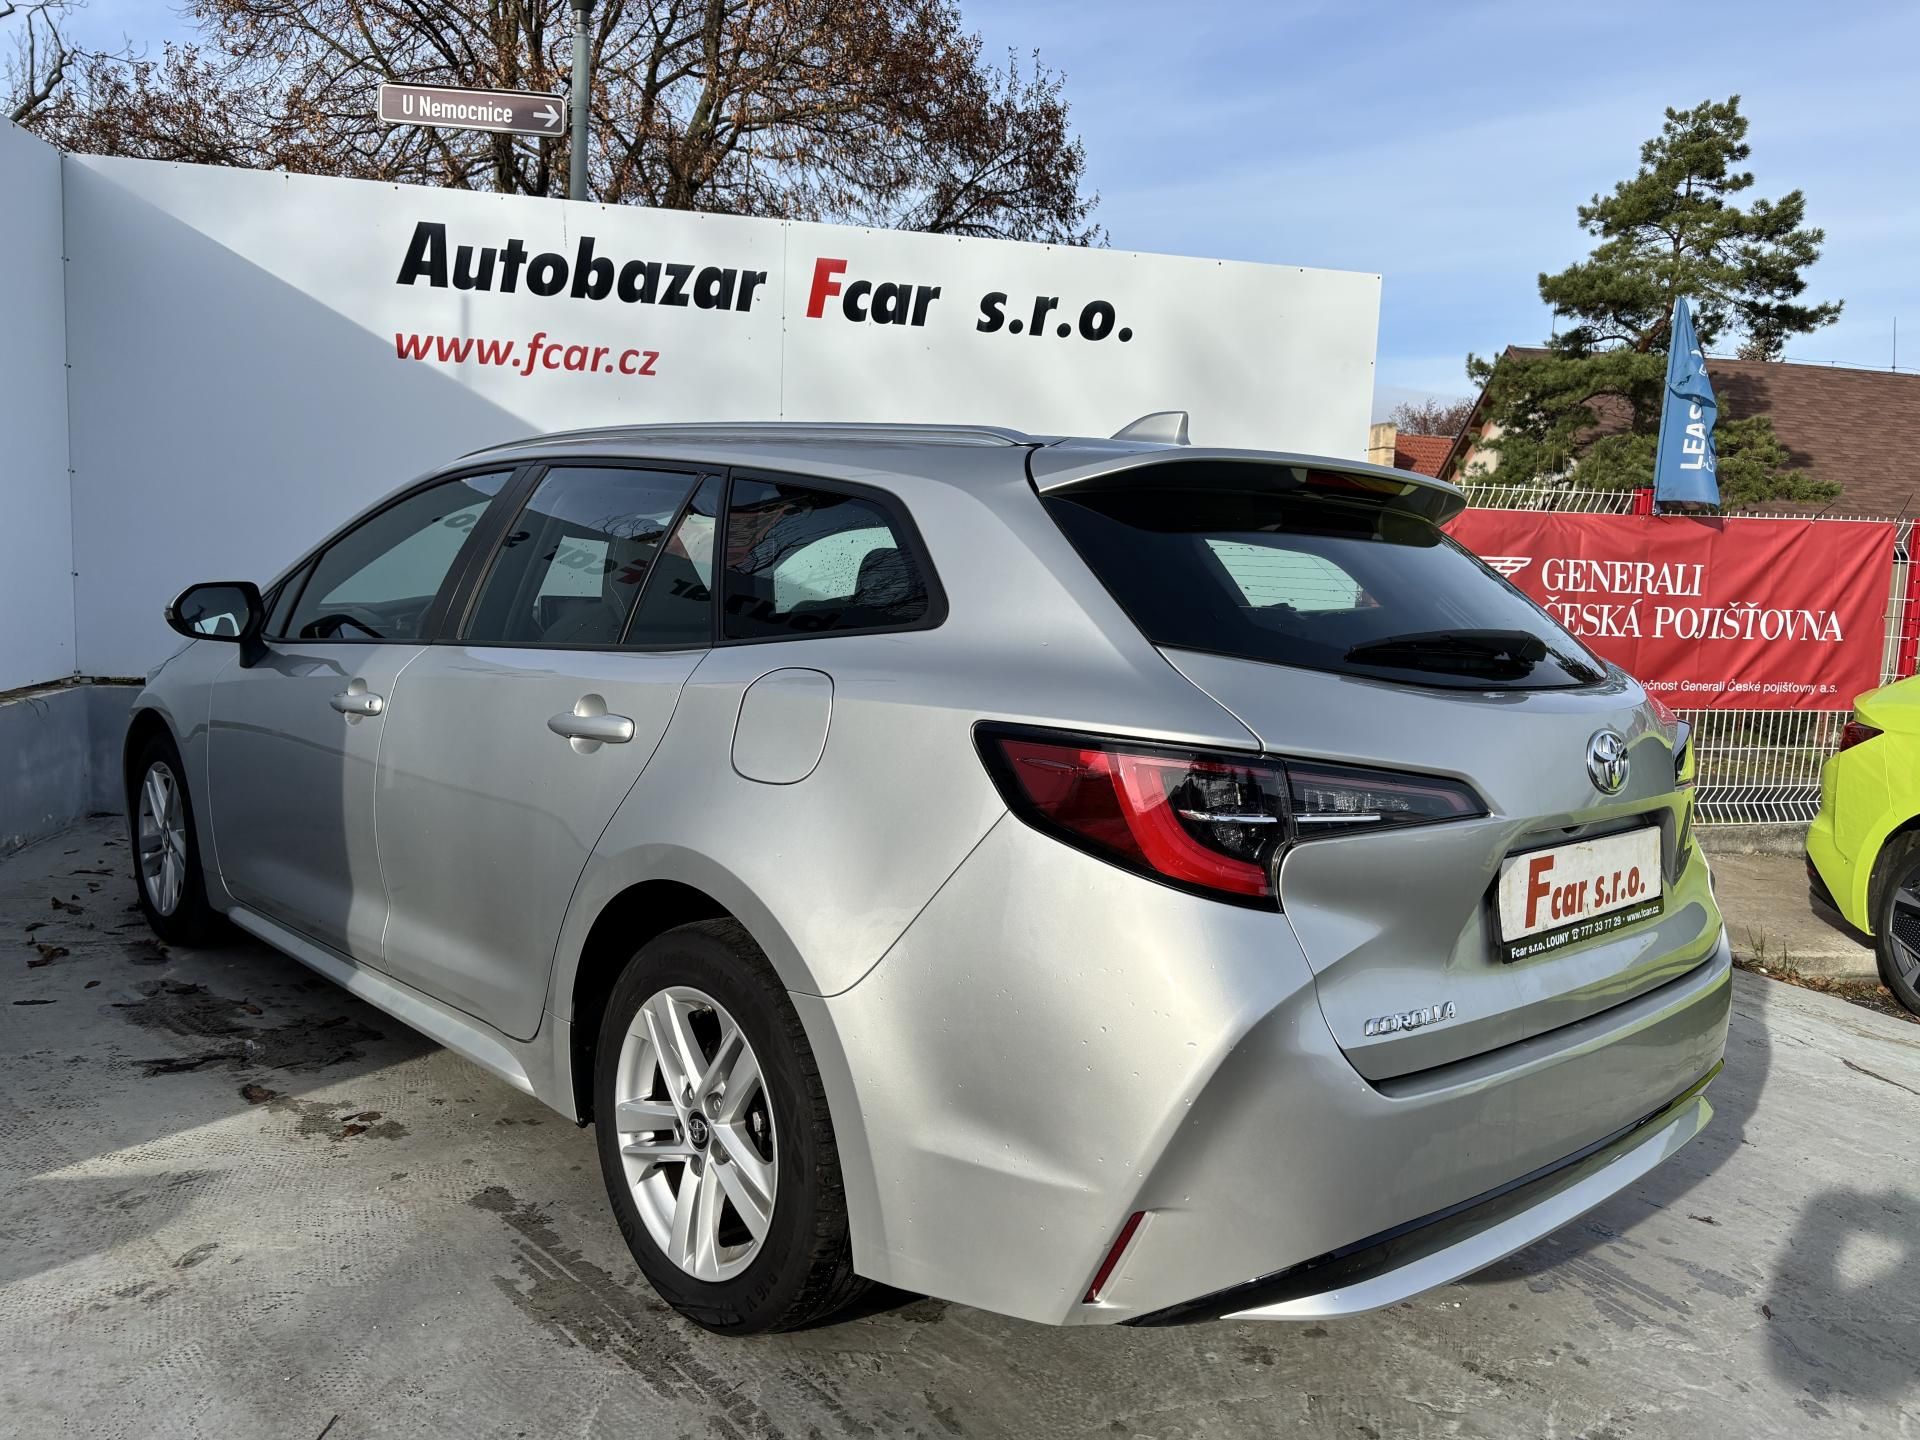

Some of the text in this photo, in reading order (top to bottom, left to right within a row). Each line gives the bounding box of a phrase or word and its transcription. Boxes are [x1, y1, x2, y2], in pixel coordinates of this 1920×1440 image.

[402, 94, 513, 123] U Nemocnice
[396, 221, 1133, 342] Autobazar Fcar s.r.o.
[395, 332, 660, 376] www.fcar.cz
[1541, 558, 1705, 596] GENERALI
[1651, 601, 1843, 642] POJIŠŤOVNA
[1681, 679, 1725, 692] Generali
[1727, 678, 1761, 692] České
[1763, 681, 1817, 695] pojišťovny
[1819, 683, 1838, 693] a.s.
[1525, 855, 1646, 929] Fcar s.r.o.
[1511, 947, 1528, 959] Fcar
[1546, 931, 1570, 948] LOUNY
[1580, 923, 1593, 937] 777
[1594, 920, 1603, 933] 33
[1604, 918, 1612, 930] 77
